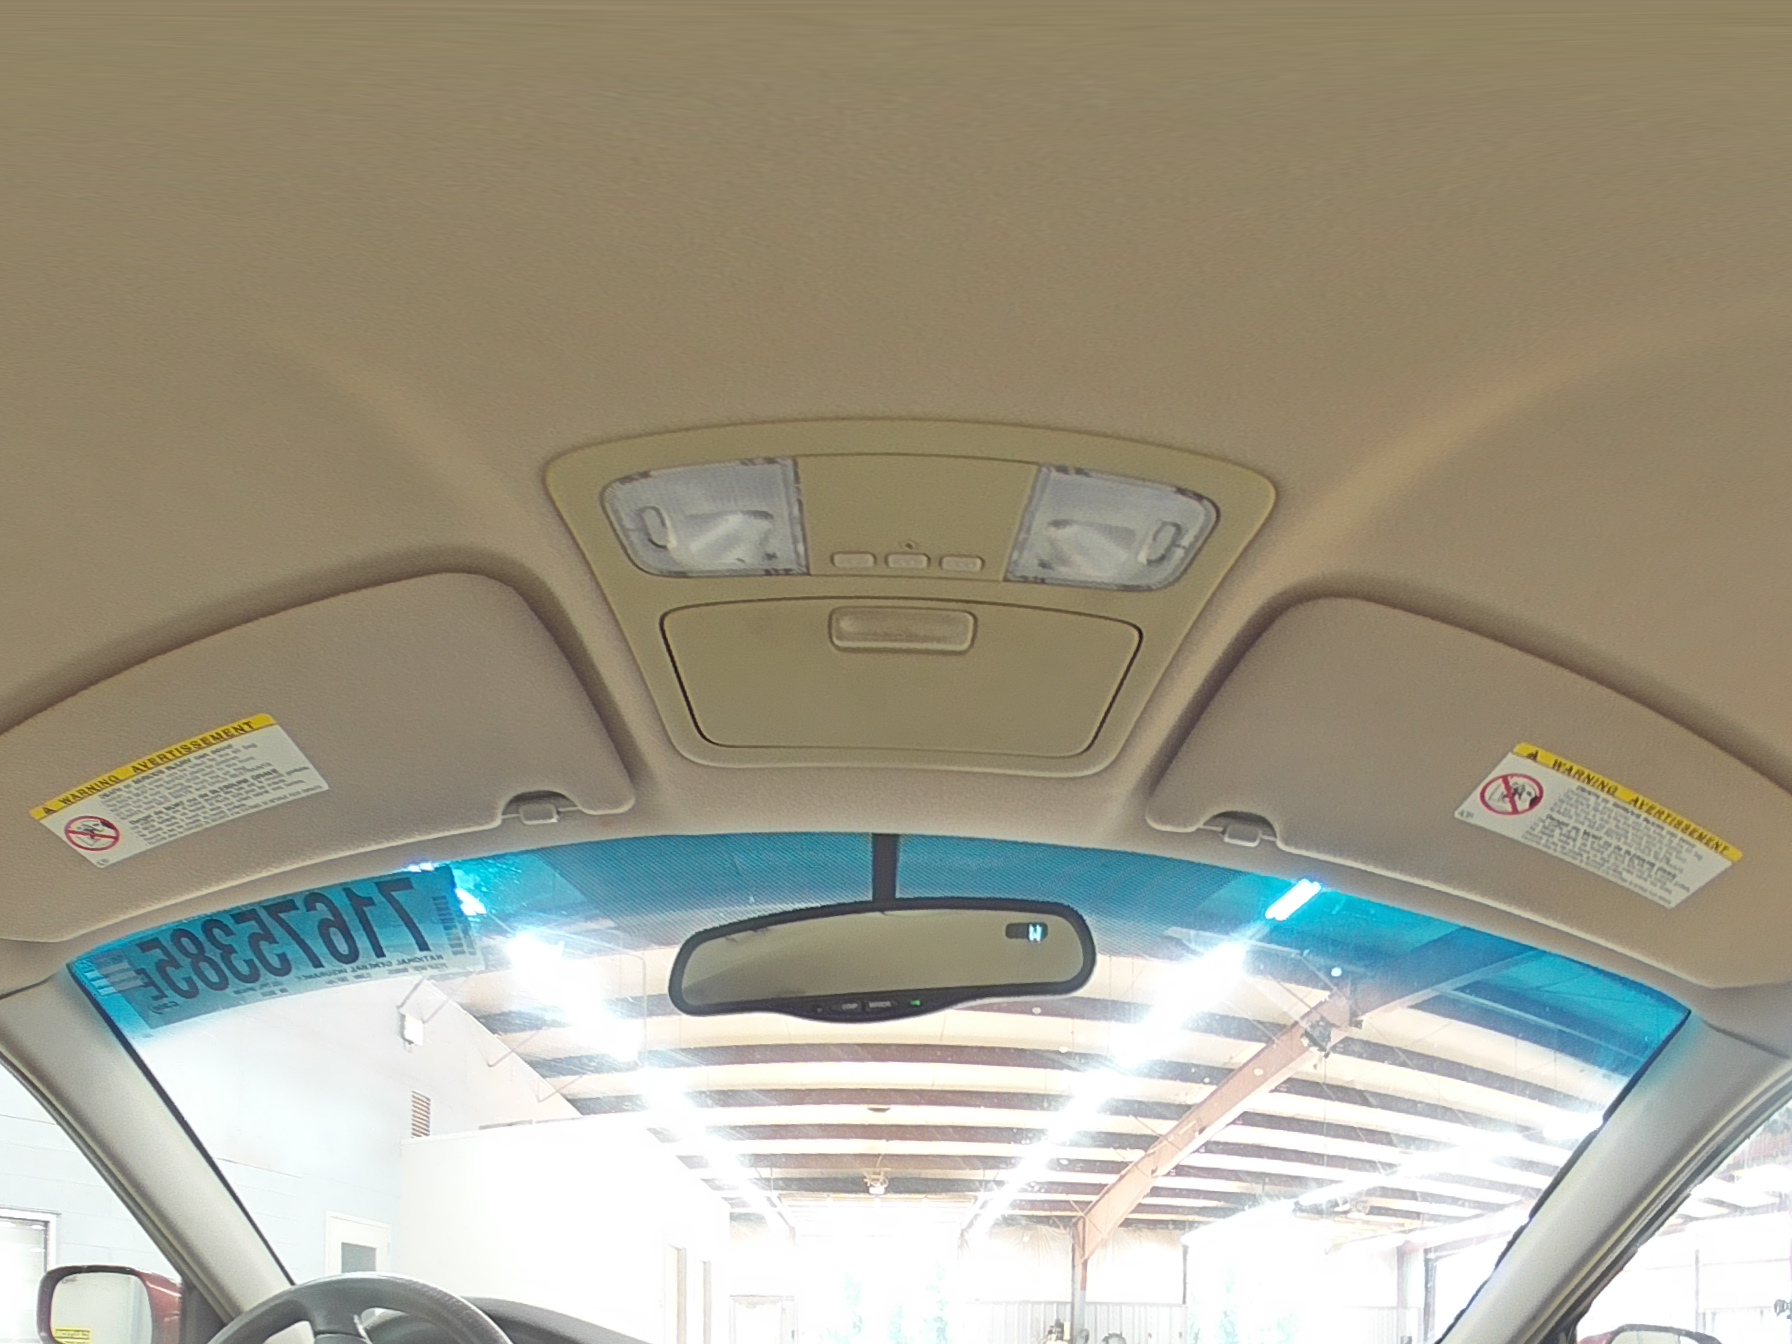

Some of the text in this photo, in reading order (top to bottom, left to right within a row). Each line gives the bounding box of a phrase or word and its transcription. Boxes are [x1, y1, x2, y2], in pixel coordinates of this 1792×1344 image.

[58, 774, 121, 806] WARNING
[130, 720, 256, 774] AVERTISSEMENT
[1551, 758, 1619, 797] WARNING
[1629, 796, 1731, 855] AVERTISSEMENT
